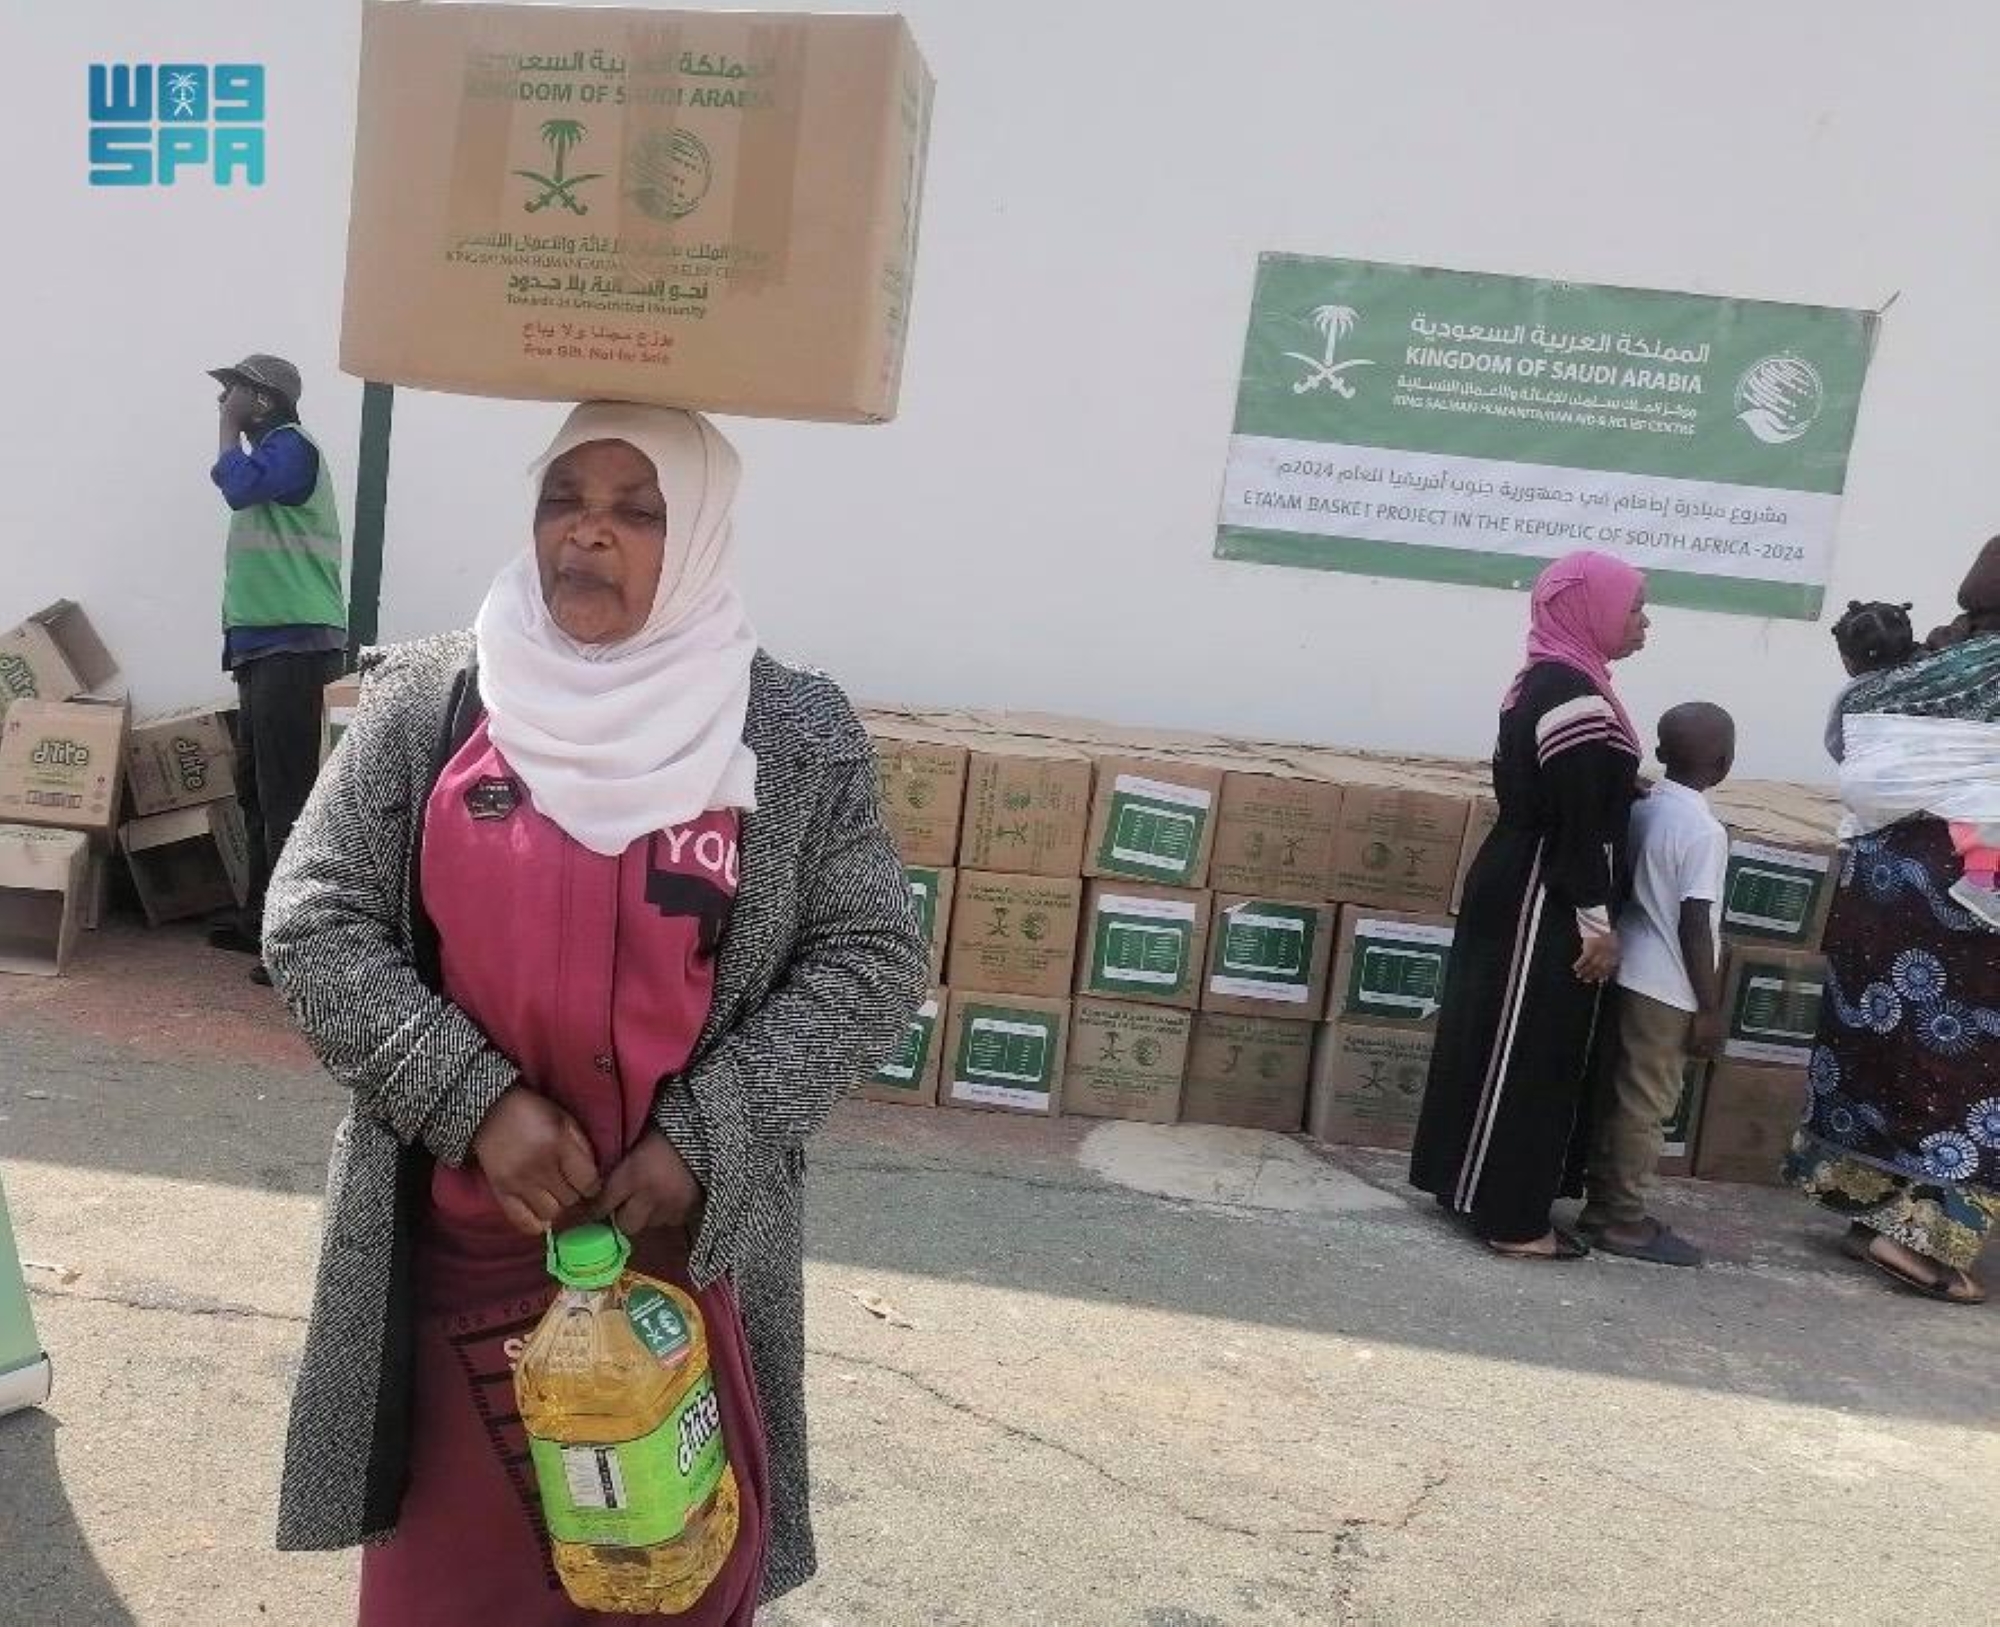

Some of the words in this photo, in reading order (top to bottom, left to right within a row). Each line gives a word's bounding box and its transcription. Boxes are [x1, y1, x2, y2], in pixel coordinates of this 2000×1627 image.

[580, 83, 609, 103] OF
[1410, 312, 1525, 344] السعودية
[1530, 324, 1610, 353] العربية
[1617, 334, 1710, 364] المملكة
[1405, 345, 1511, 375] KINGDOM
[1517, 357, 1547, 378] OF
[1550, 361, 1616, 386] SAUDI
[1620, 369, 1702, 394] ARABIA
[1451, 478, 1494, 498] جنوب
[1674, 498, 1727, 521] مبادرة
[1729, 506, 1788, 525] مشروع
[1307, 497, 1371, 518] BASKET
[1376, 504, 1446, 526] PROJECT
[1452, 511, 1472, 528] IN
[1478, 514, 1509, 532] THE
[1599, 526, 1622, 543] OF
[1625, 529, 1686, 549] SOUTH
[1691, 537, 1750, 557] AFRICA
